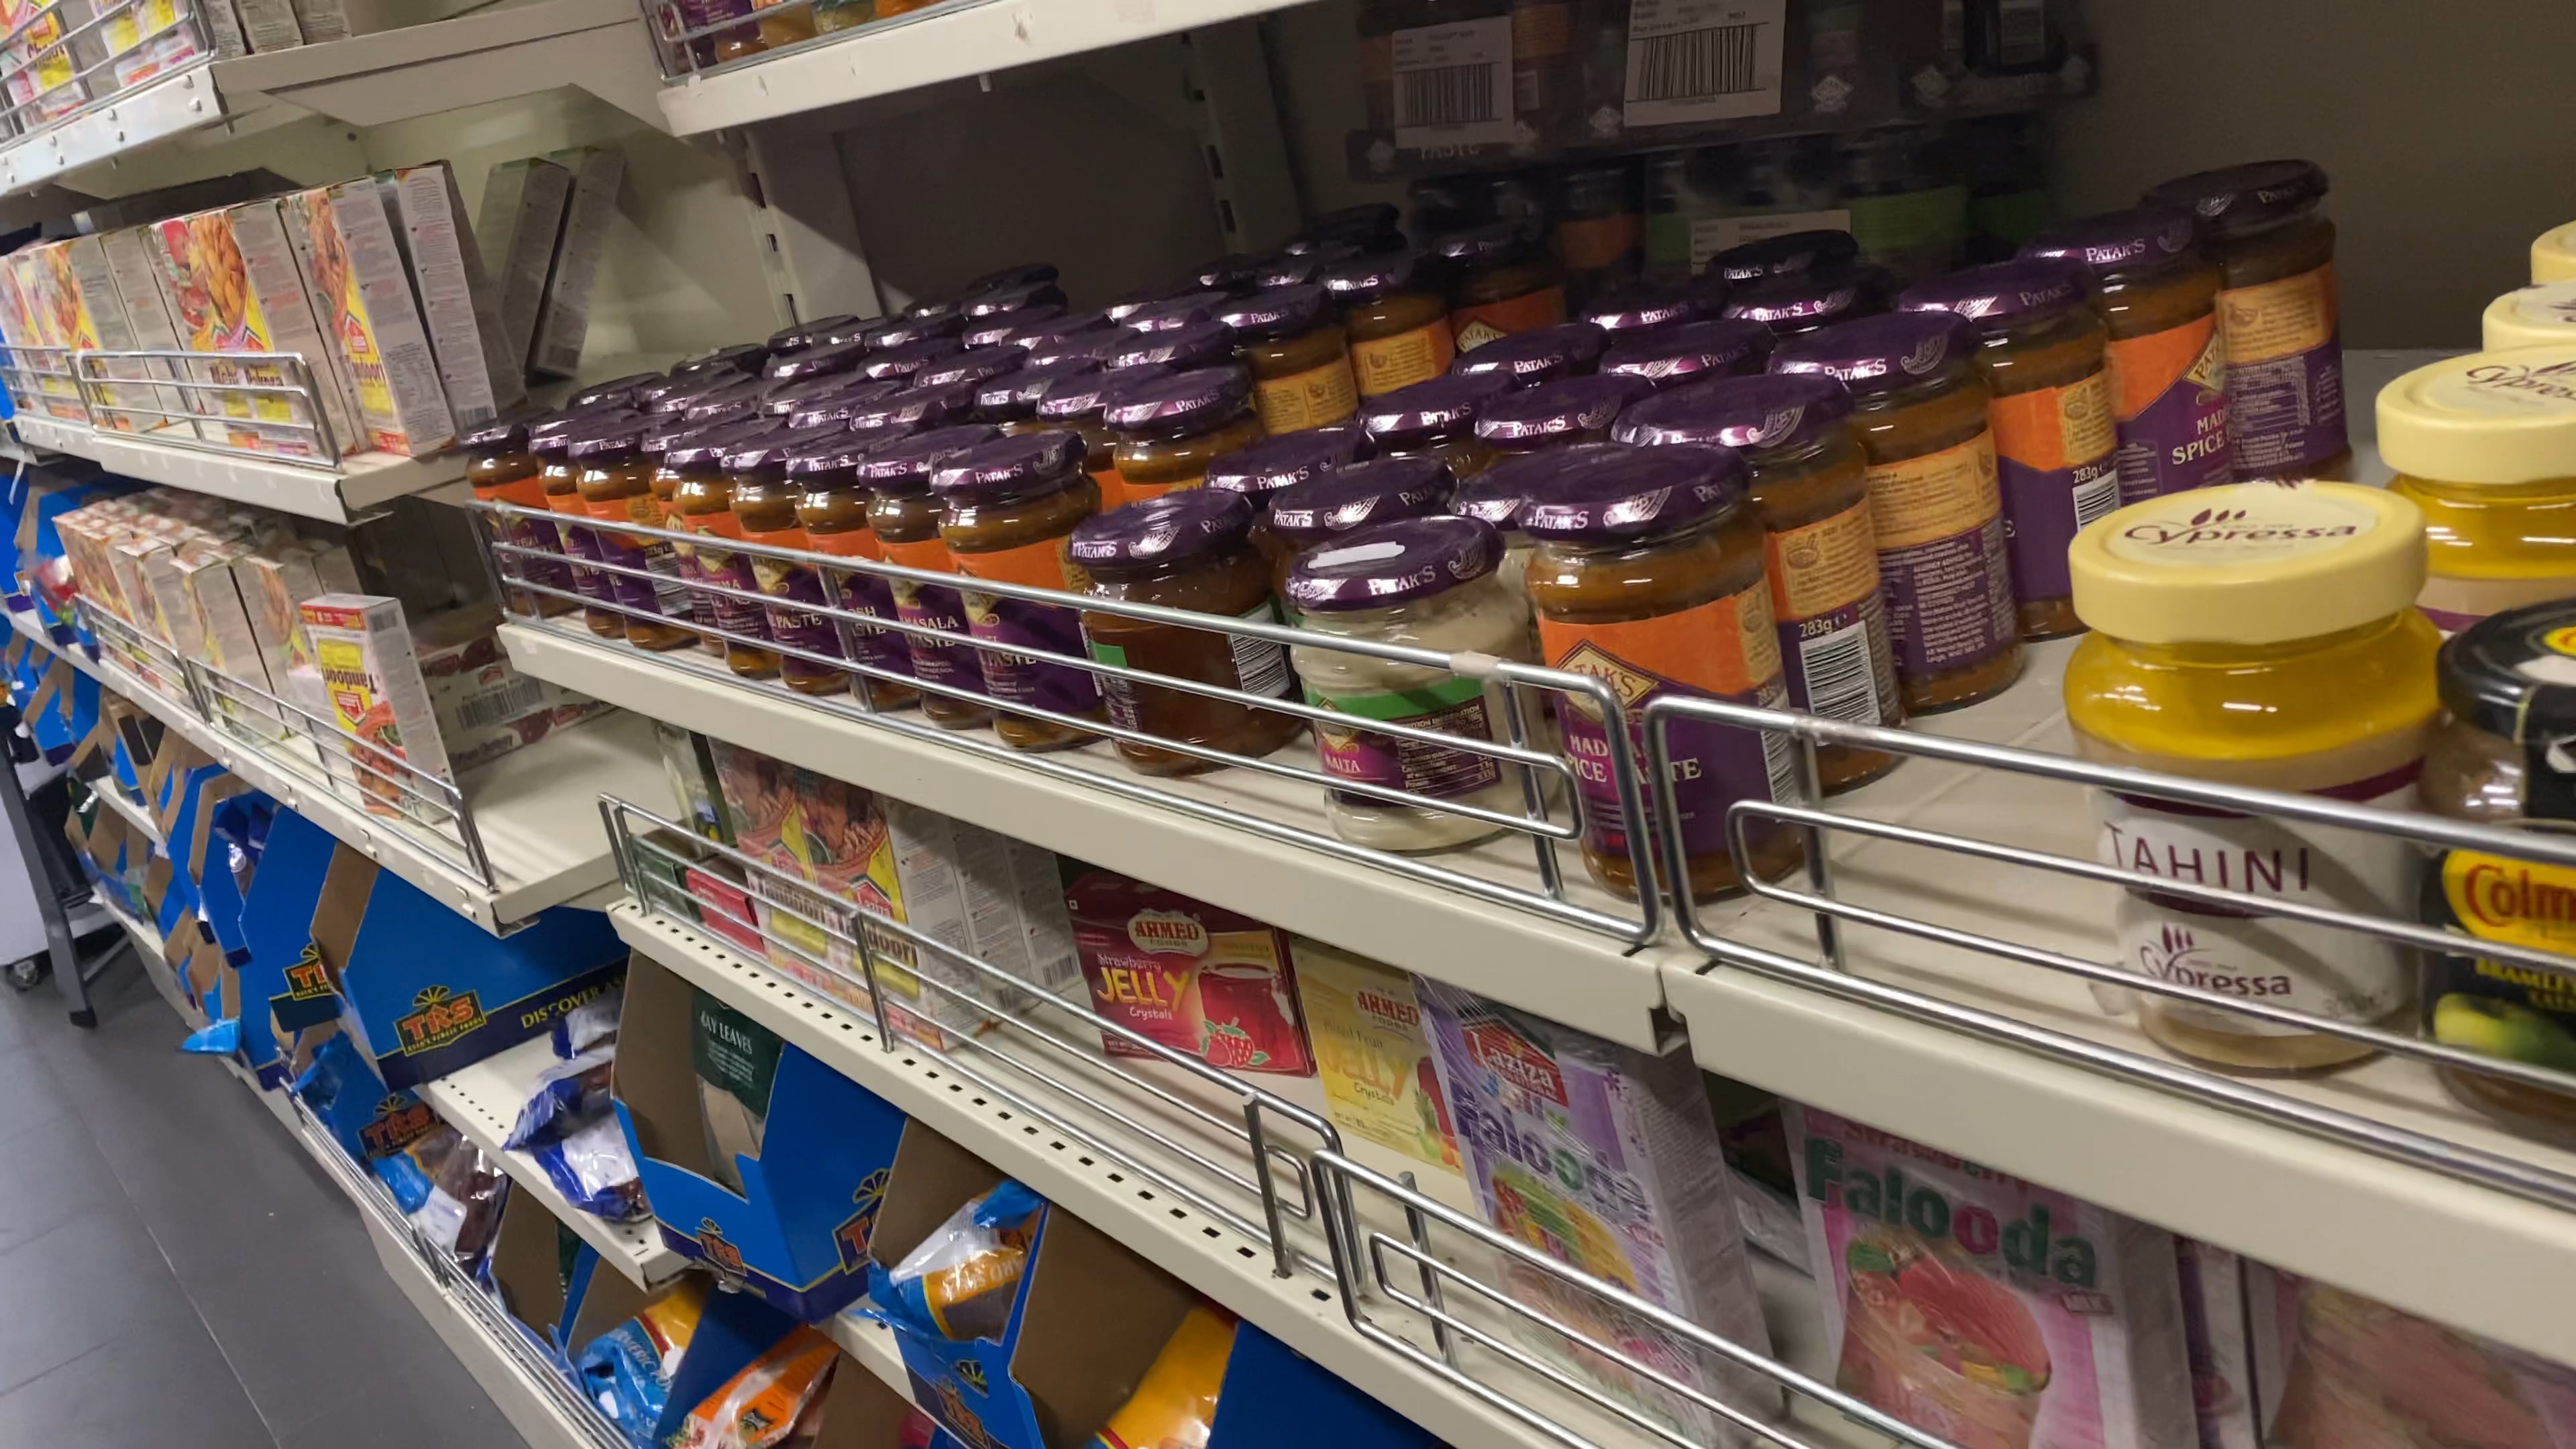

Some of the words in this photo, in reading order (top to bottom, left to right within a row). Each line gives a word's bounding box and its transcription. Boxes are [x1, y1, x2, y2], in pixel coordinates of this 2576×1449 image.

[2086, 239, 2145, 262] PATAK'S
[1755, 303, 1803, 321] PATAK'S
[1513, 352, 1564, 374] PATAK'S
[1824, 358, 1887, 381] PATAK'S
[1420, 402, 1472, 426] PATAK'S
[1513, 415, 1566, 437] PATAK'S
[2172, 431, 2224, 466] SPICE
[870, 462, 908, 478] PATAK'S
[975, 464, 1024, 484] PATAK'S
[1256, 466, 1309, 490] PATAK'S
[1275, 509, 1314, 528] PATAK'S
[1534, 509, 1589, 531] PATAK'S
[2124, 521, 2357, 545] Cypressa
[1077, 541, 1118, 559] PATAK'S
[1368, 566, 1436, 596] PATAK'S
[1799, 620, 1833, 639] 283g
[2104, 821, 2309, 893] TAHINI
[1135, 921, 1199, 941] AHMED
[1097, 954, 1162, 973] Strawberry
[1097, 967, 1190, 1012] JELLY
[402, 996, 474, 1040] TRS
[1130, 1007, 1173, 1021] Crystals
[1357, 990, 1420, 1027] AHMED
[1354, 1081, 1395, 1107] Crystals
[1806, 1138, 2097, 1289] Falooda
